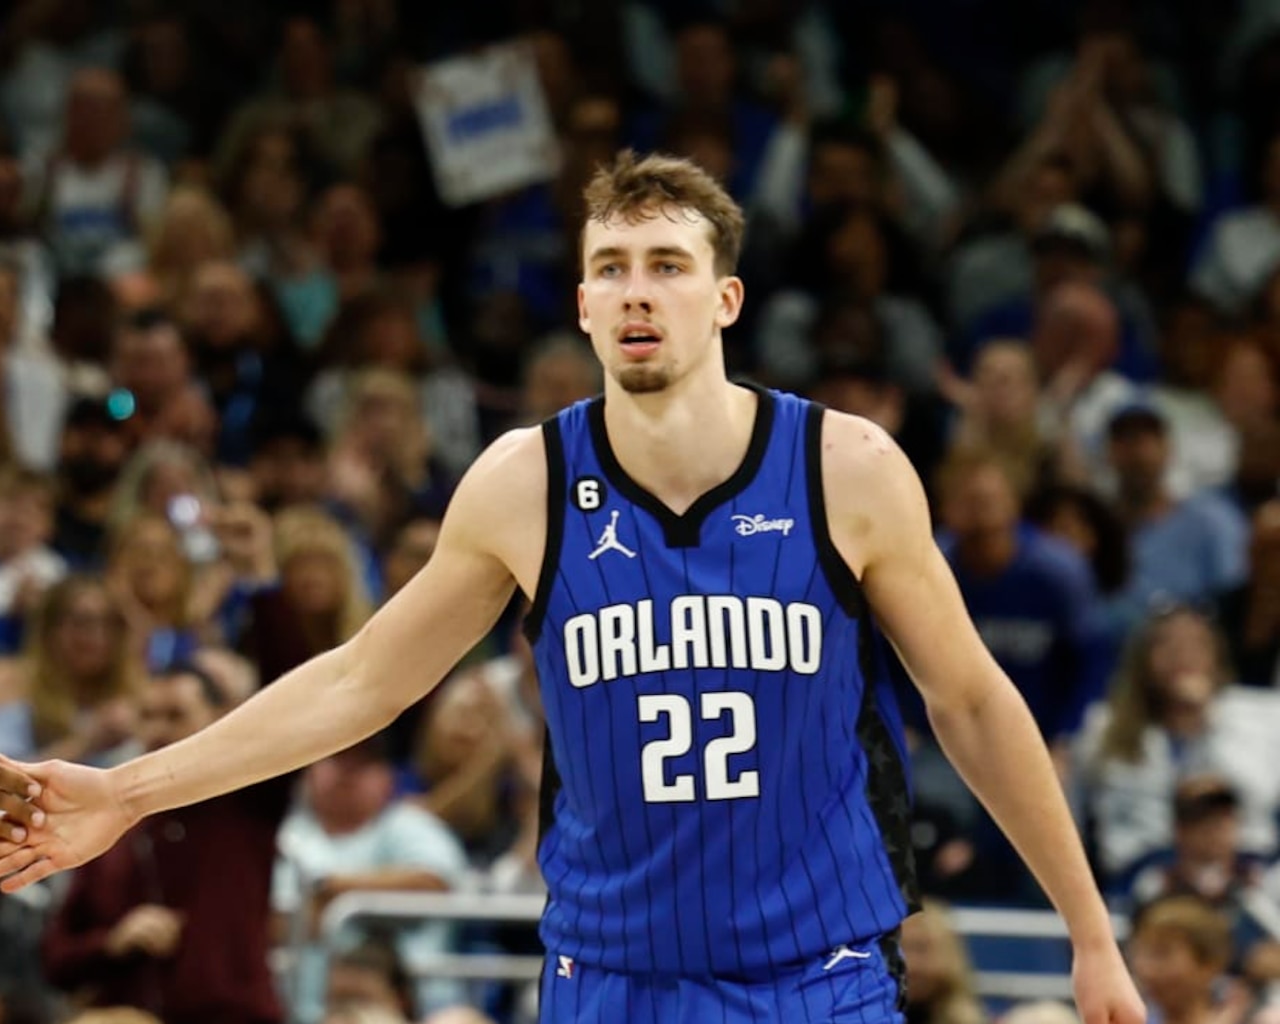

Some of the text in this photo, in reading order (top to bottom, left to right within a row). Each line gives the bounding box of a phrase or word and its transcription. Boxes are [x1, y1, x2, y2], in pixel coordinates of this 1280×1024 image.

[577, 480, 600, 510] 6
[564, 595, 821, 688] ORLANDO
[638, 691, 759, 802] 22
